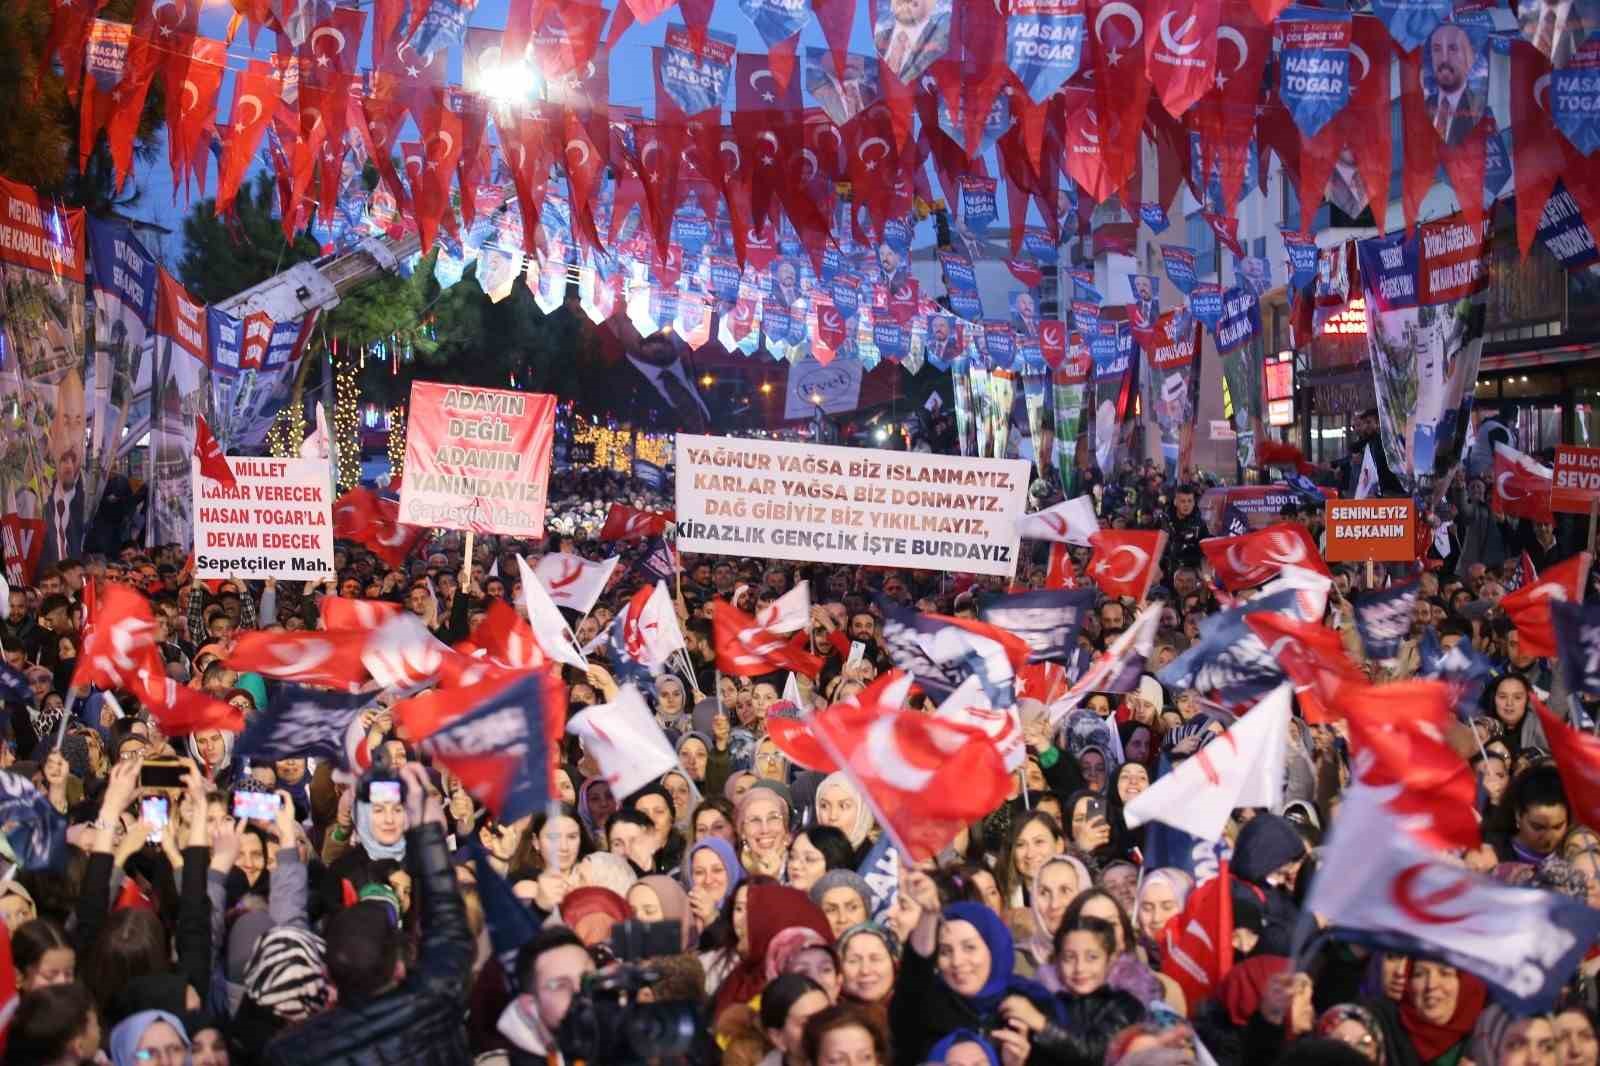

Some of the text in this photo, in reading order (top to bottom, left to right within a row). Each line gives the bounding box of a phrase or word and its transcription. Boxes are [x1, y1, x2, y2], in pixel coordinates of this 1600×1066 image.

[1014, 22, 1078, 40] HASAN
[90, 45, 126, 57] HASAN
[1015, 41, 1075, 60] TOGAR
[1285, 56, 1345, 75] HASAN
[1287, 76, 1343, 93] TOGAR
[15, 228, 41, 257] KAPALI
[1289, 246, 1315, 259] HASAN
[443, 388, 526, 417] ADAYIN
[448, 413, 514, 442] DEĞİL
[436, 445, 522, 473] ADAMIN
[688, 446, 771, 470] YAĞMUR
[777, 454, 843, 477] YAĞSA
[849, 458, 882, 479] BİZ
[1559, 453, 1577, 465] BU
[235, 462, 287, 477] MİLLET
[201, 484, 323, 502] KARAR VERECEK
[409, 472, 542, 503] YANINDAYIZ
[694, 473, 777, 495] KARLAR
[782, 479, 848, 501] YAĞSA
[854, 484, 886, 503] BİZ
[200, 507, 326, 526] HASAN TOGAR'LA
[704, 497, 989, 538] DAĞ GİBİYİZ BİZ YIKILMAYIZ,
[207, 532, 321, 549] DEVAM EDECEK
[675, 519, 766, 544] KİRAZLIK
[770, 527, 859, 552] GENÇLİK
[862, 532, 907, 555] İŞTE
[1336, 525, 1404, 540] BAŞKANIM
[197, 554, 333, 574] Sepetçiler Mah.
